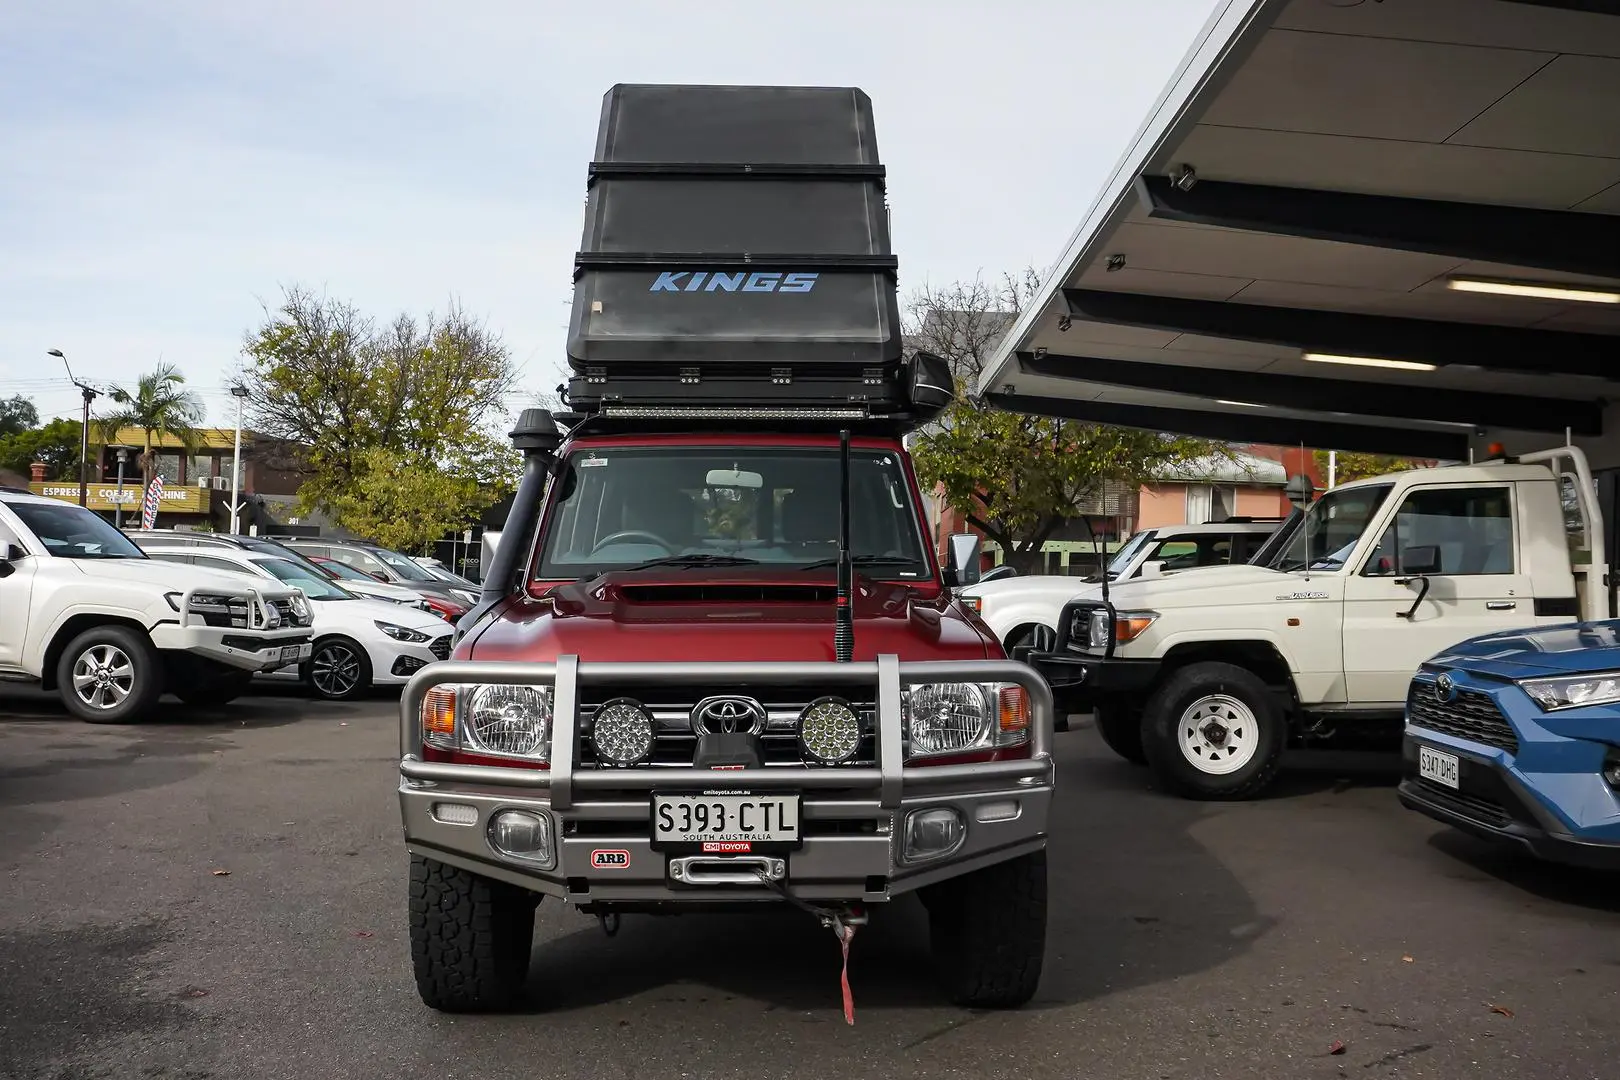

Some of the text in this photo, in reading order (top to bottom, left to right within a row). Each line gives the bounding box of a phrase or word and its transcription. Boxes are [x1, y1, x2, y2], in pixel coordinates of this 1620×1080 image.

[649, 271, 819, 293] KINGS
[703, 788, 751, 796] cmitoyota.com.au
[682, 833, 772, 841] SOUTH AUSTRALIA
[595, 853, 626, 864] ARB
